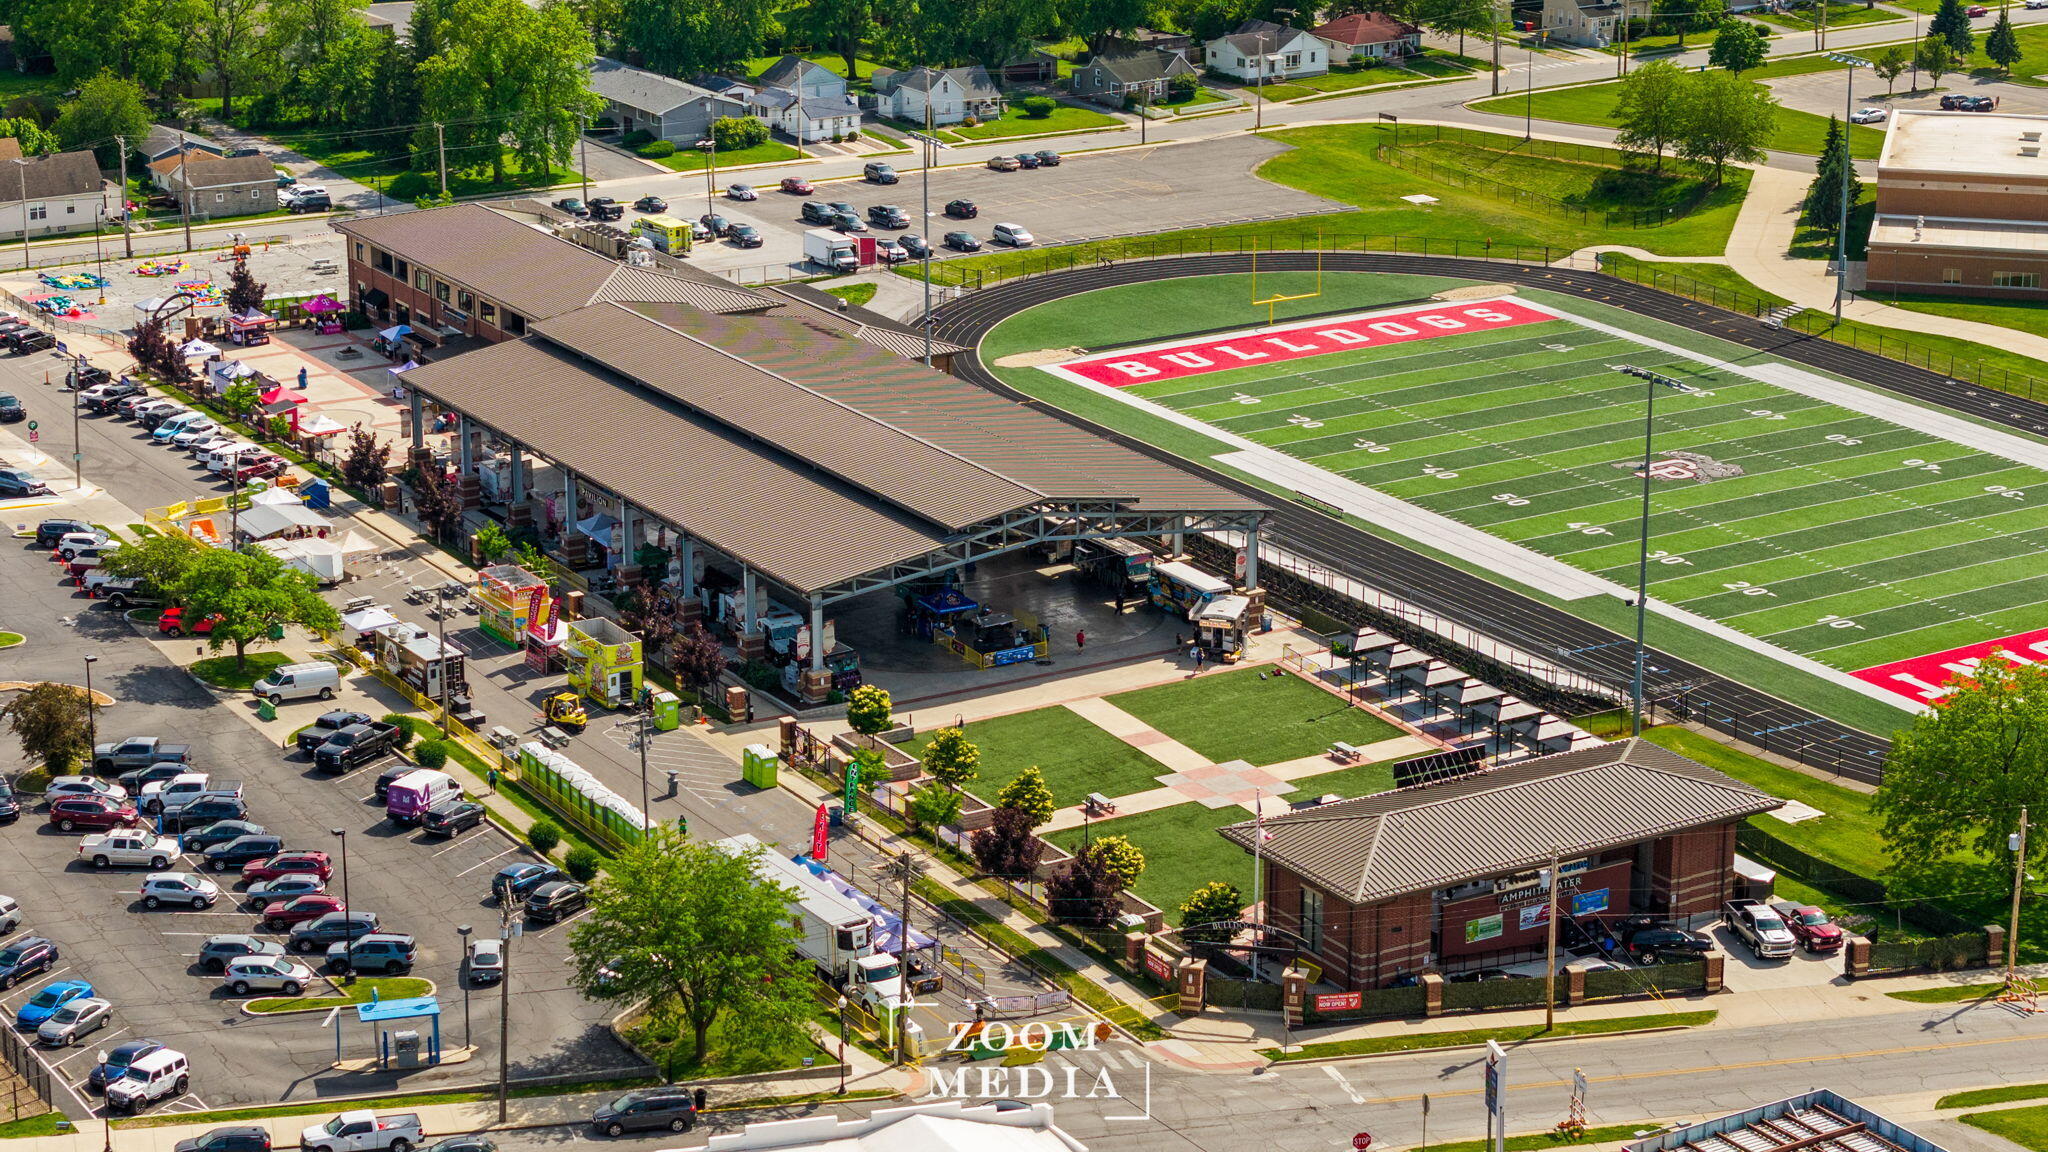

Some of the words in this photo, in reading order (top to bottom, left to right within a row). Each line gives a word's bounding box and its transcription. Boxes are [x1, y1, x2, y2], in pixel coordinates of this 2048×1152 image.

[1105, 308, 1513, 378] BULLDOGS
[1287, 414, 1325, 428] 20
[1825, 434, 1863, 445] 50
[1353, 441, 1390, 453] 30
[1902, 459, 1942, 470] 40
[1422, 467, 1460, 480] 40
[582, 488, 608, 508] PAVILION
[1984, 485, 2025, 498] 30
[1491, 493, 1531, 506] 50
[1566, 522, 1607, 535] 40
[1646, 550, 1686, 565] 30
[1722, 581, 1769, 595] 20
[1817, 614, 1856, 628] 10
[848, 763, 858, 813] ENTRANCE
[816, 812, 826, 853] EXIT
[1501, 877, 1582, 904] AMPHITHATER
[1212, 920, 1252, 930] BULLDOG
[1256, 923, 1277, 936] PARK
[1353, 1136, 1371, 1146] STOP
